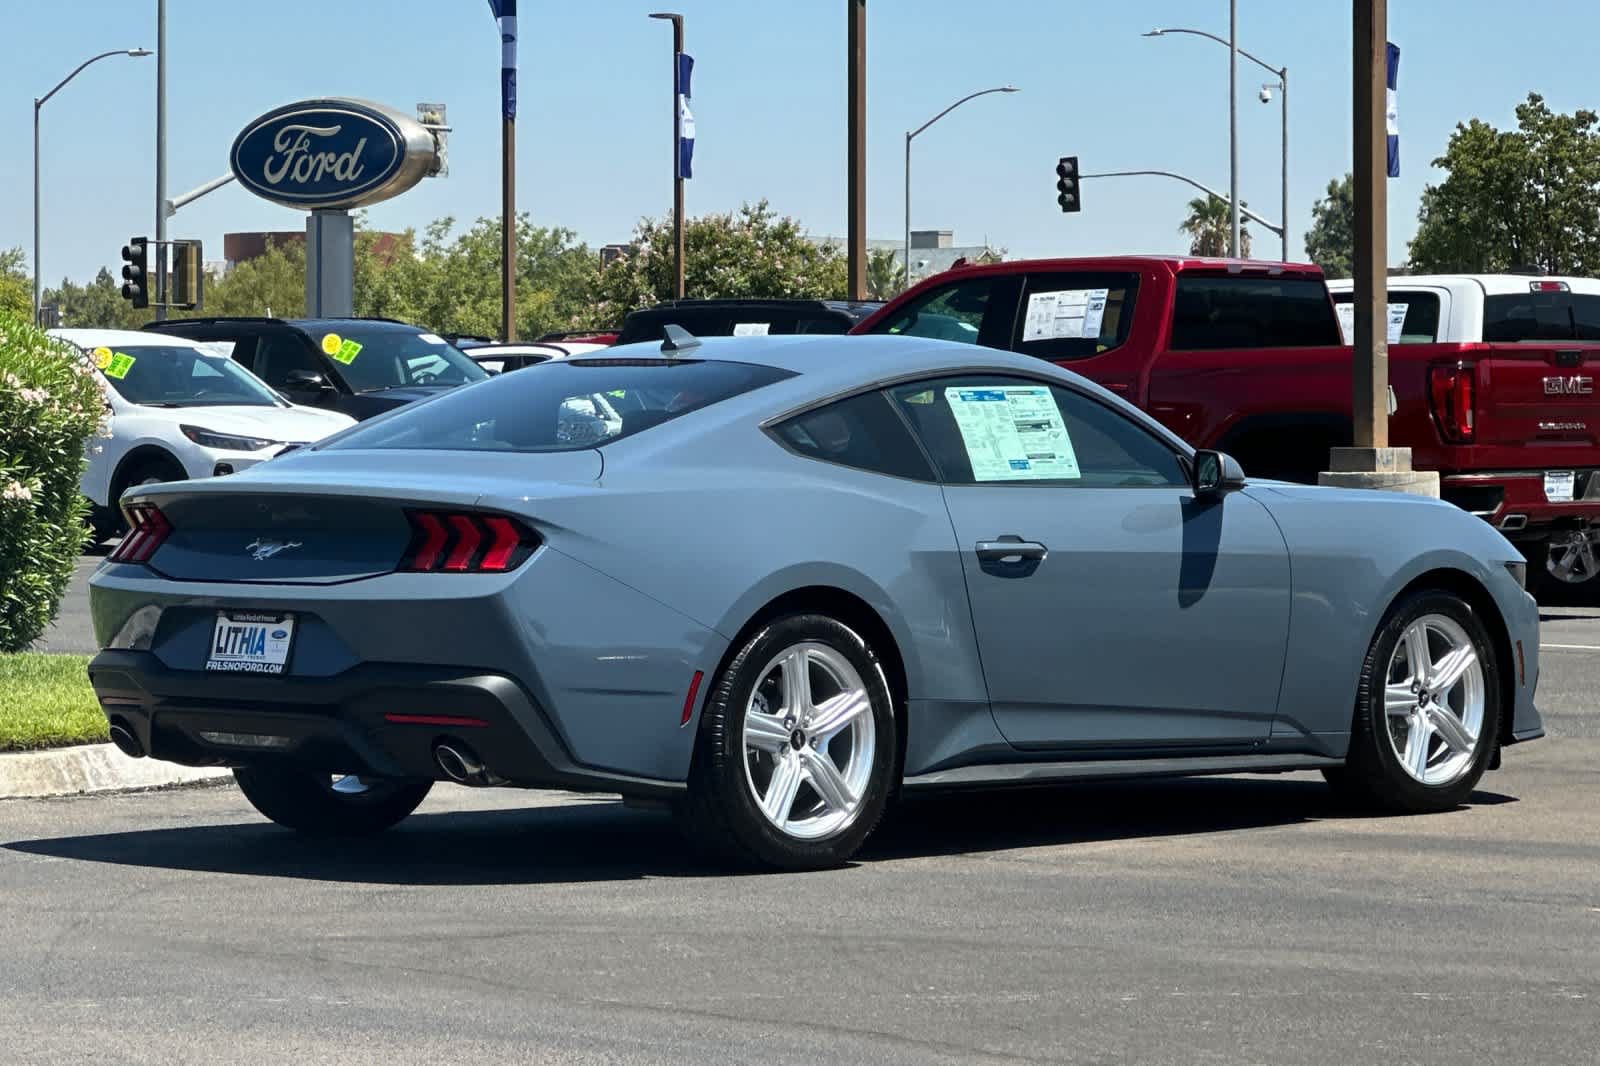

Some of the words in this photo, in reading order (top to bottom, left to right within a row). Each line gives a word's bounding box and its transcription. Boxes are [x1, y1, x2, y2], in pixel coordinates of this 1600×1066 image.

[263, 124, 368, 184] Ford
[1543, 376, 1593, 394] GMC
[215, 625, 266, 655] LITHIA
[206, 661, 283, 674] FRESNOFORD.COM
